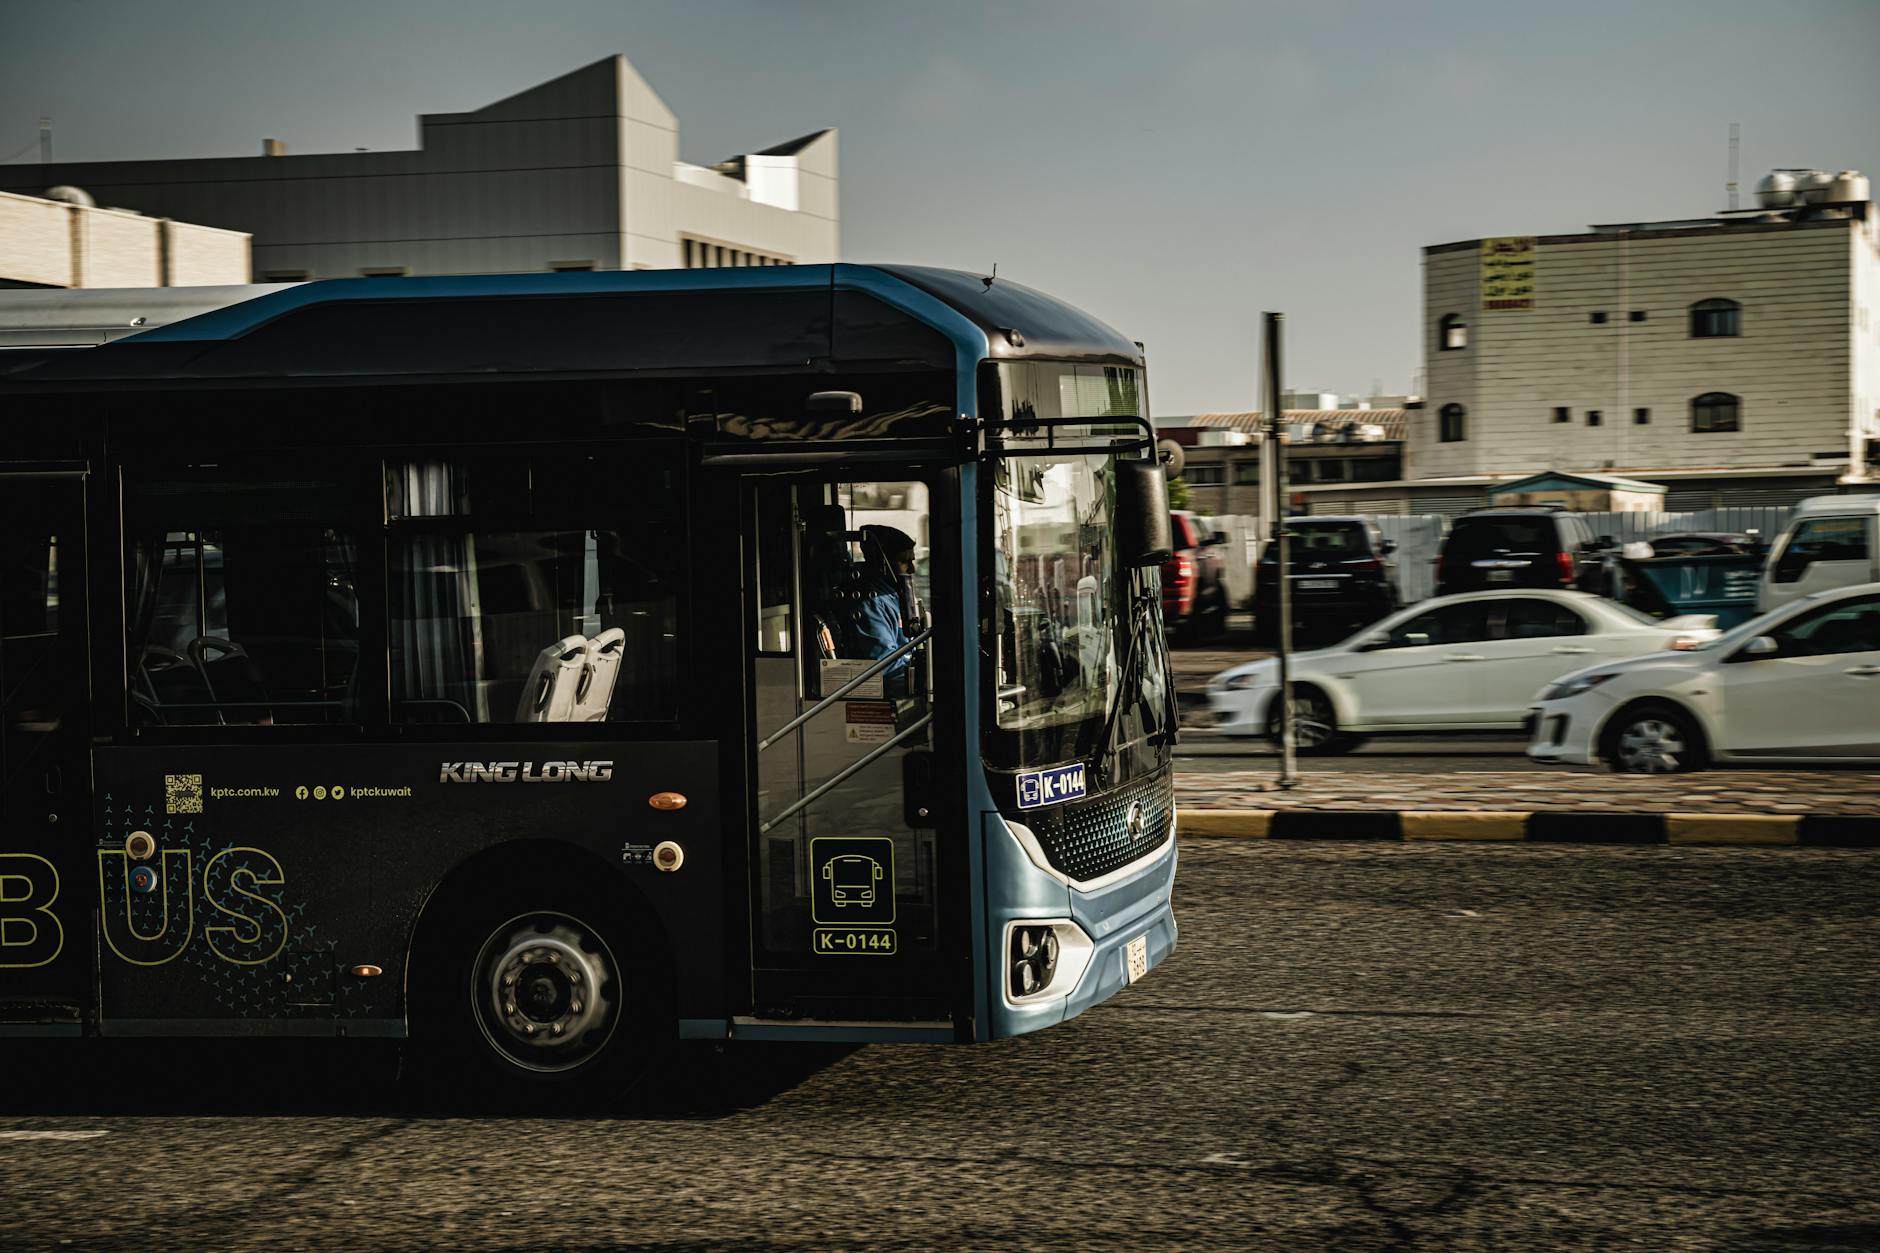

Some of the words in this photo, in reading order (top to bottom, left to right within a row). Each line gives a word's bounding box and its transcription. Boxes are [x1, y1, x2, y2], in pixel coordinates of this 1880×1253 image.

[440, 761, 518, 783] KING
[522, 760, 613, 783] LONG
[210, 786, 280, 798] kptc.com.kw
[350, 786, 412, 798] kptckuwait
[1044, 769, 1084, 799] K-0144
[821, 933, 892, 950] K-0144
